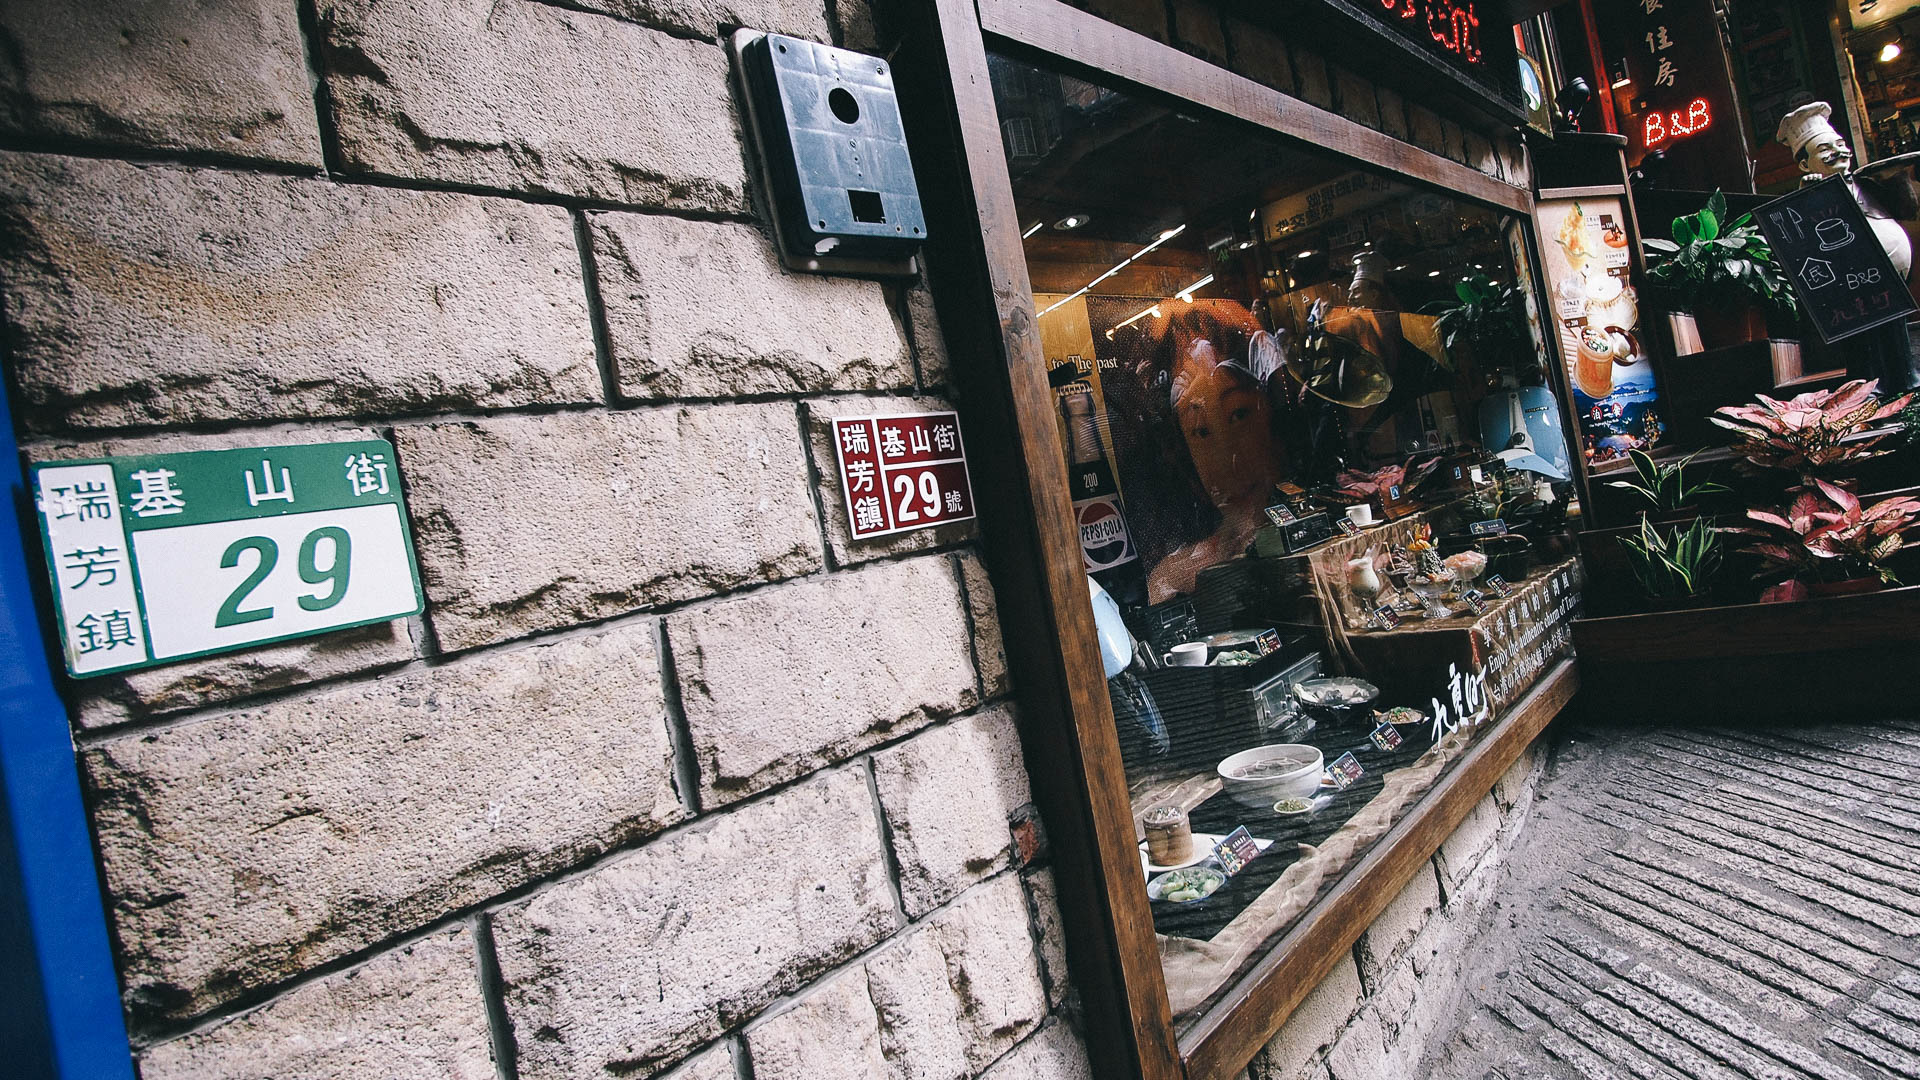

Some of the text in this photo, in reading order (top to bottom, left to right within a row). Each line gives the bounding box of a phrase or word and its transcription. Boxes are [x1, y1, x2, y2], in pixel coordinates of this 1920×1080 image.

[1644, 99, 1710, 147] B&B
[1846, 268, 1881, 290] B&B
[1067, 355, 1093, 371] The
[1096, 356, 1119, 374] past
[881, 424, 956, 458] 基山街
[131, 453, 391, 518] 基山街
[841, 424, 884, 531] 瑞芳鎮
[1083, 472, 1099, 489] 200
[50, 479, 137, 656] 瑞芳鎮
[214, 525, 353, 630] 29
[1488, 650, 1509, 674] Enjoy
[1509, 641, 1519, 658] the
[1519, 618, 1545, 650] authentic
[1544, 608, 1560, 628] charm
[1559, 599, 1566, 616] of
